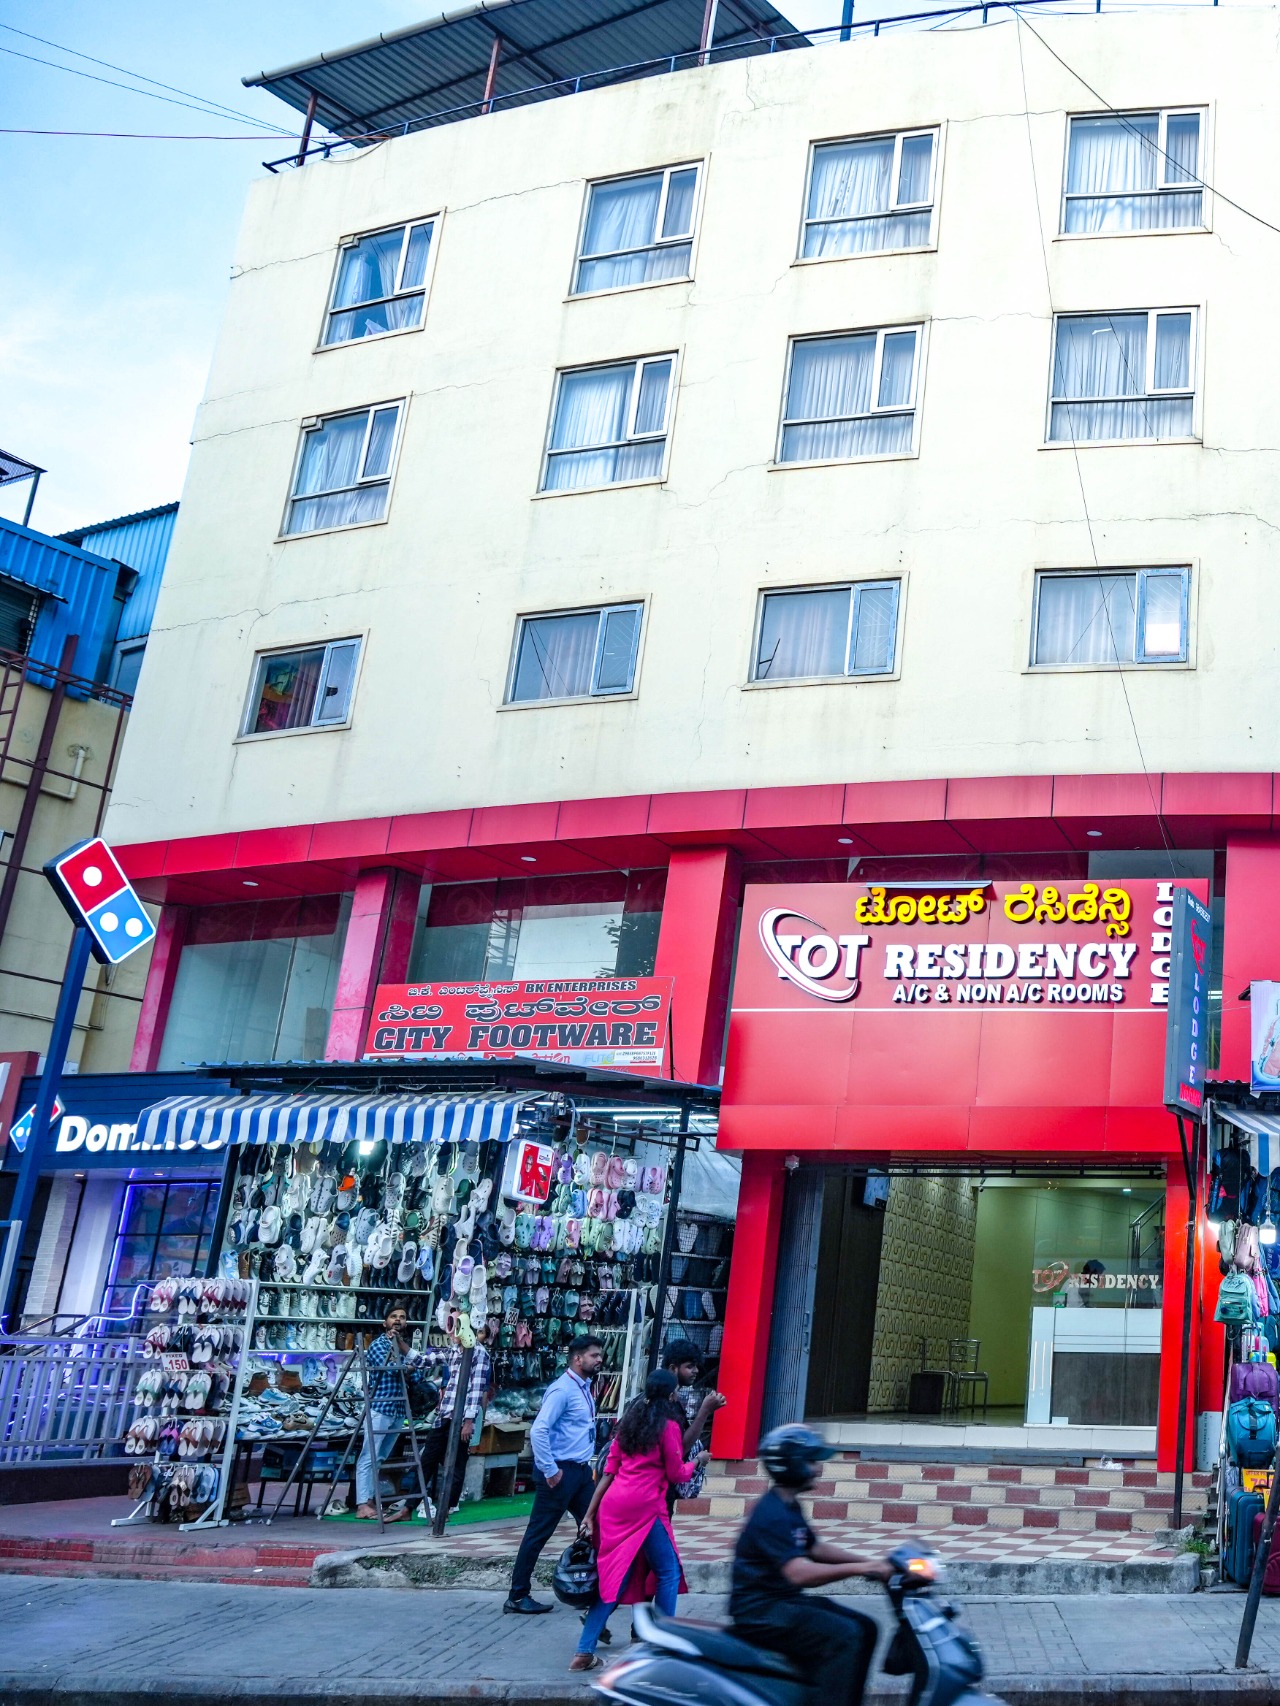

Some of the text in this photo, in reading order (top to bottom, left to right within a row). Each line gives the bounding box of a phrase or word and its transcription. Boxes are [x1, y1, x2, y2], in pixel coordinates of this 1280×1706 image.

[777, 934, 1137, 979] TOT RESIDENCY
[525, 982, 545, 994] BK
[547, 980, 637, 992] ENTERPRISES
[892, 983, 1123, 1002] A/C & NON A/C ROOMS
[373, 1022, 659, 1051] CITY FOOTWARE
[1189, 973, 1200, 1084] LODGE
[1068, 1273, 1160, 1289] RESIDENCY
[169, 1359, 187, 1370] 150
